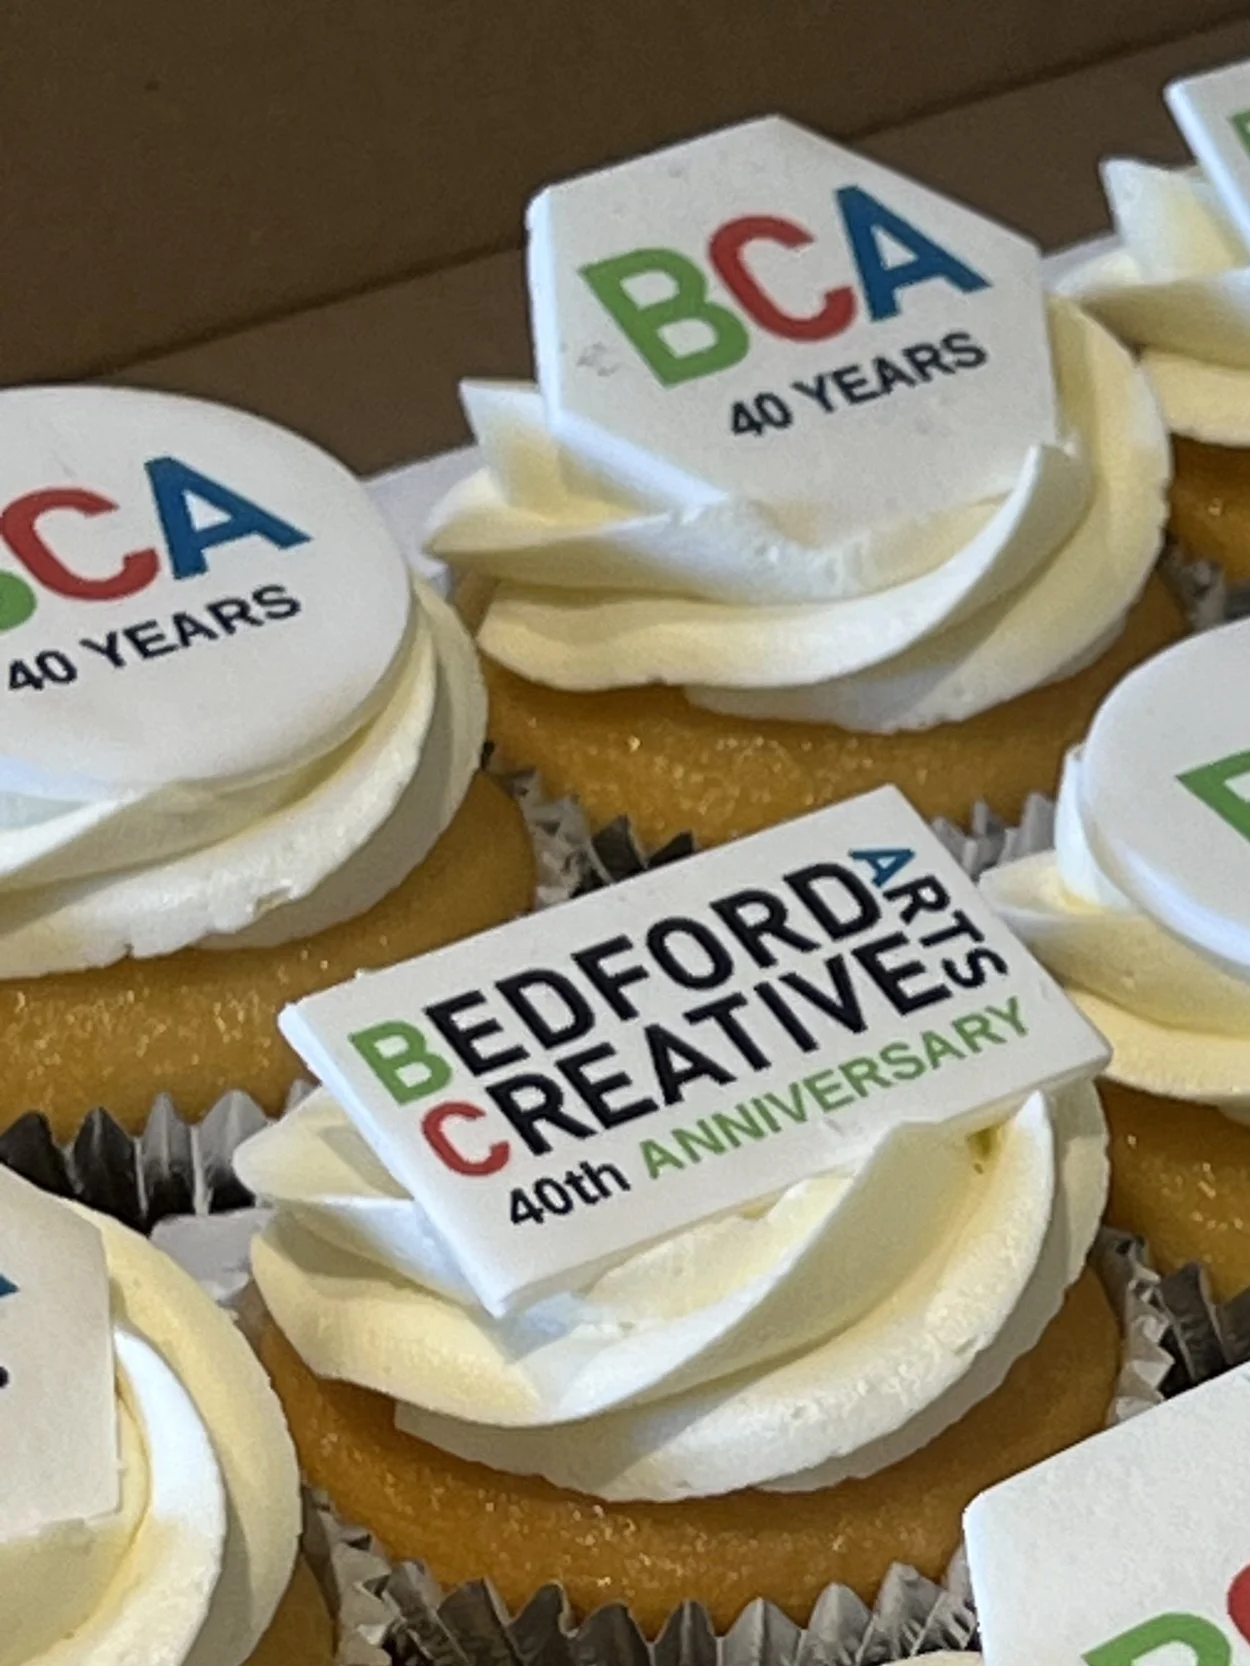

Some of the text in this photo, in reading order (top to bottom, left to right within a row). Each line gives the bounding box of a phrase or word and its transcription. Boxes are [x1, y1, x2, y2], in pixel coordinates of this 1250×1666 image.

[576, 184, 993, 390] BCA
[730, 331, 988, 438] 40 YEARS
[0, 456, 313, 633] CA
[8, 583, 301, 691] 40 YEARS
[348, 862, 883, 1106] BEDFORD
[848, 847, 1008, 993] ARTS
[420, 930, 952, 1177] CREATIVE
[508, 996, 1031, 1226] 40th ANNIVERSARY
